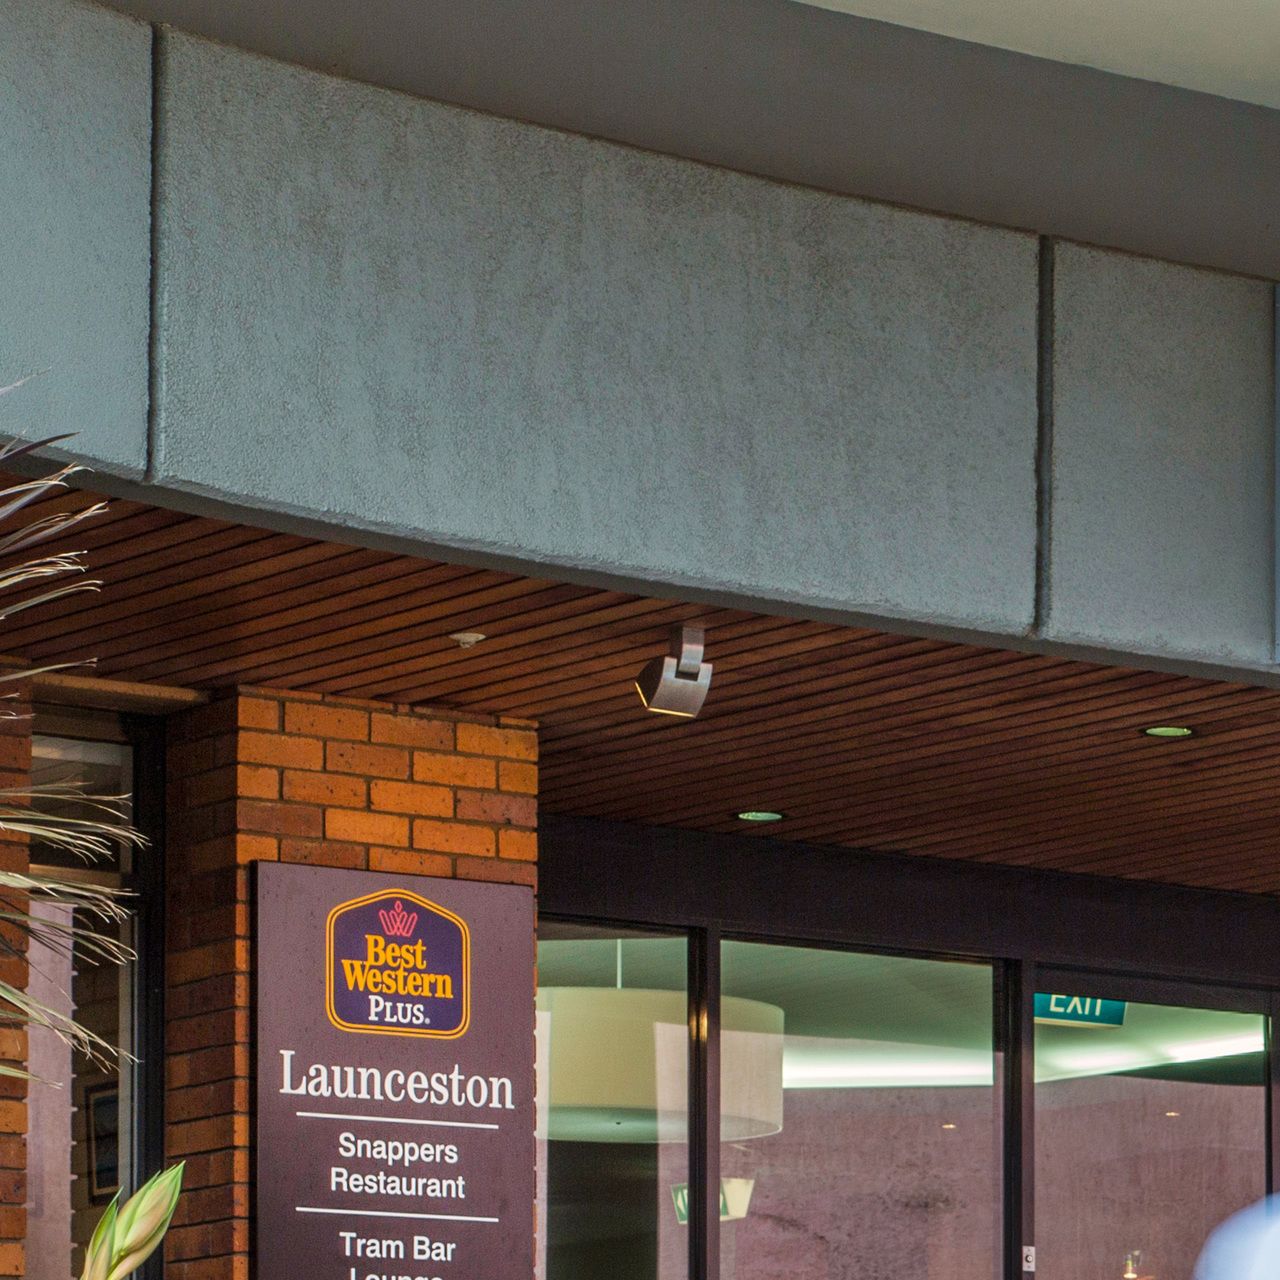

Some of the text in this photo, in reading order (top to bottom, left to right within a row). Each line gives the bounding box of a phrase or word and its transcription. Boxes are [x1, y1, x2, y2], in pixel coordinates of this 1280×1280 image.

[364, 934, 427, 970] Best
[341, 959, 454, 999] Western
[279, 1049, 515, 1110] Launceston
[338, 1132, 459, 1167] Snappers
[330, 1166, 466, 1199] Restaurant
[339, 1231, 457, 1262] Tram Bar
